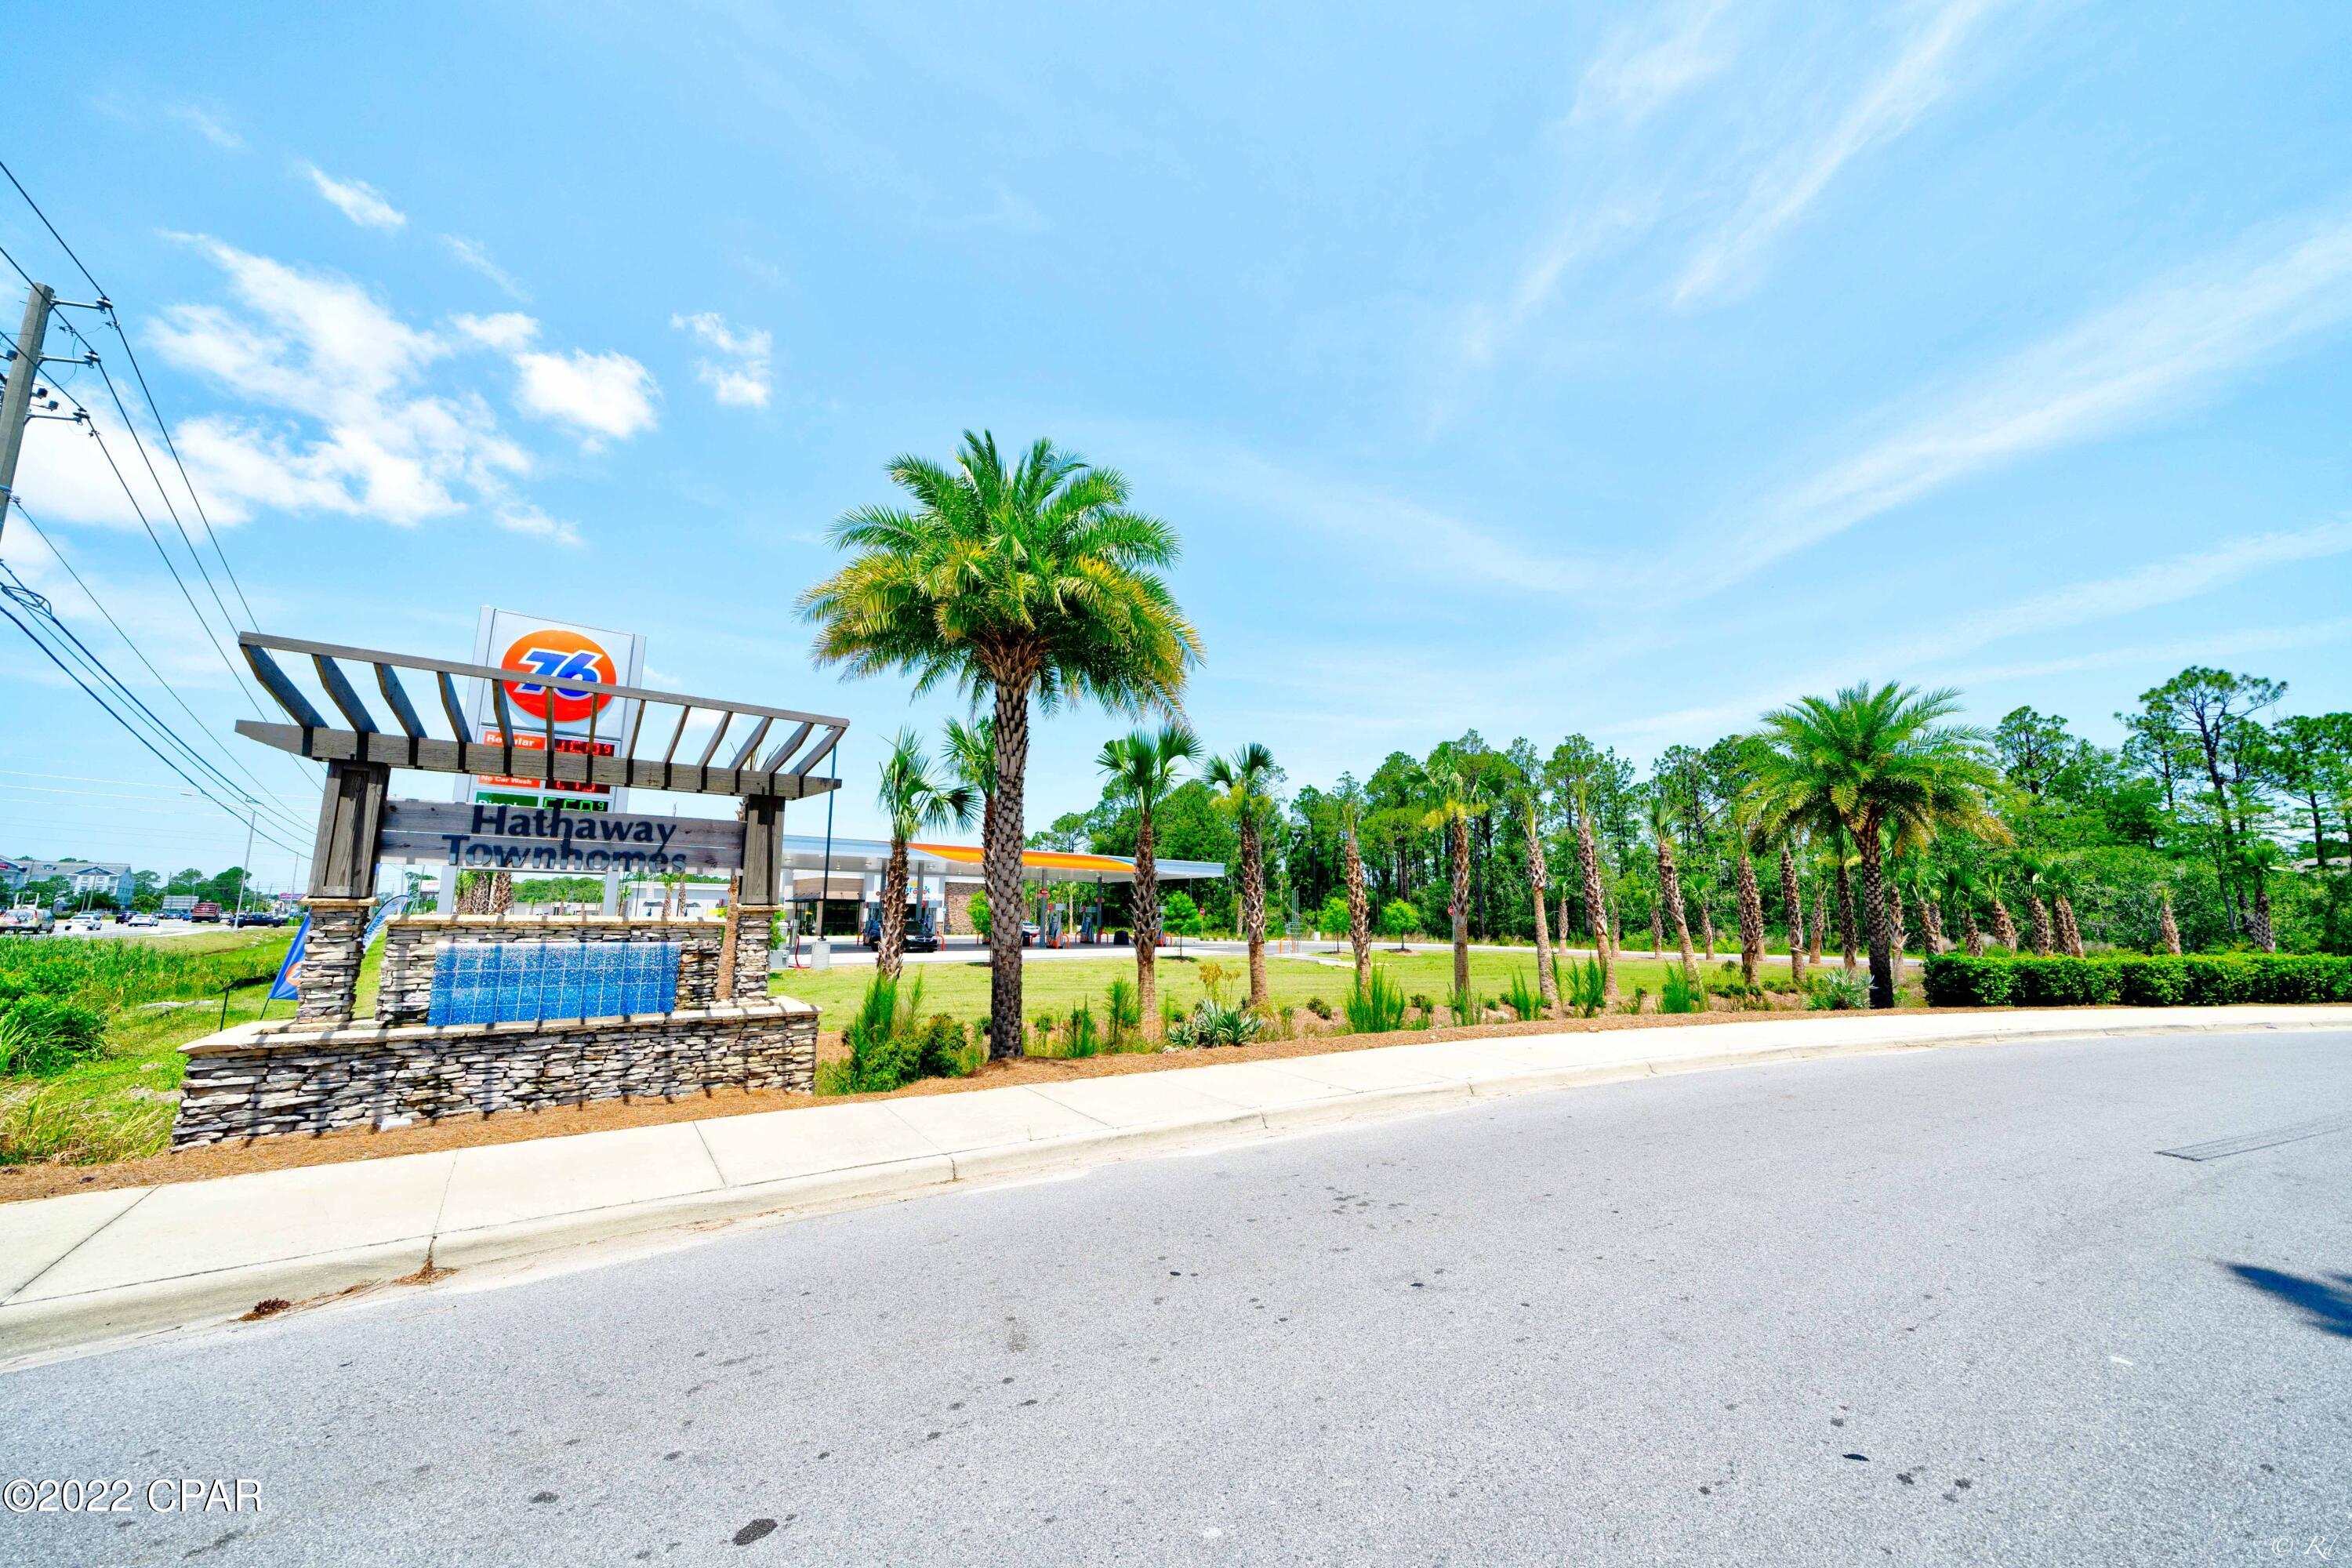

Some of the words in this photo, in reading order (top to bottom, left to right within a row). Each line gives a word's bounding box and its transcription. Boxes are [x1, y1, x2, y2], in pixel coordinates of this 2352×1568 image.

[514, 648, 604, 700] 76
[442, 833, 687, 873] Townhomes
[471, 804, 677, 853] Hathaway
